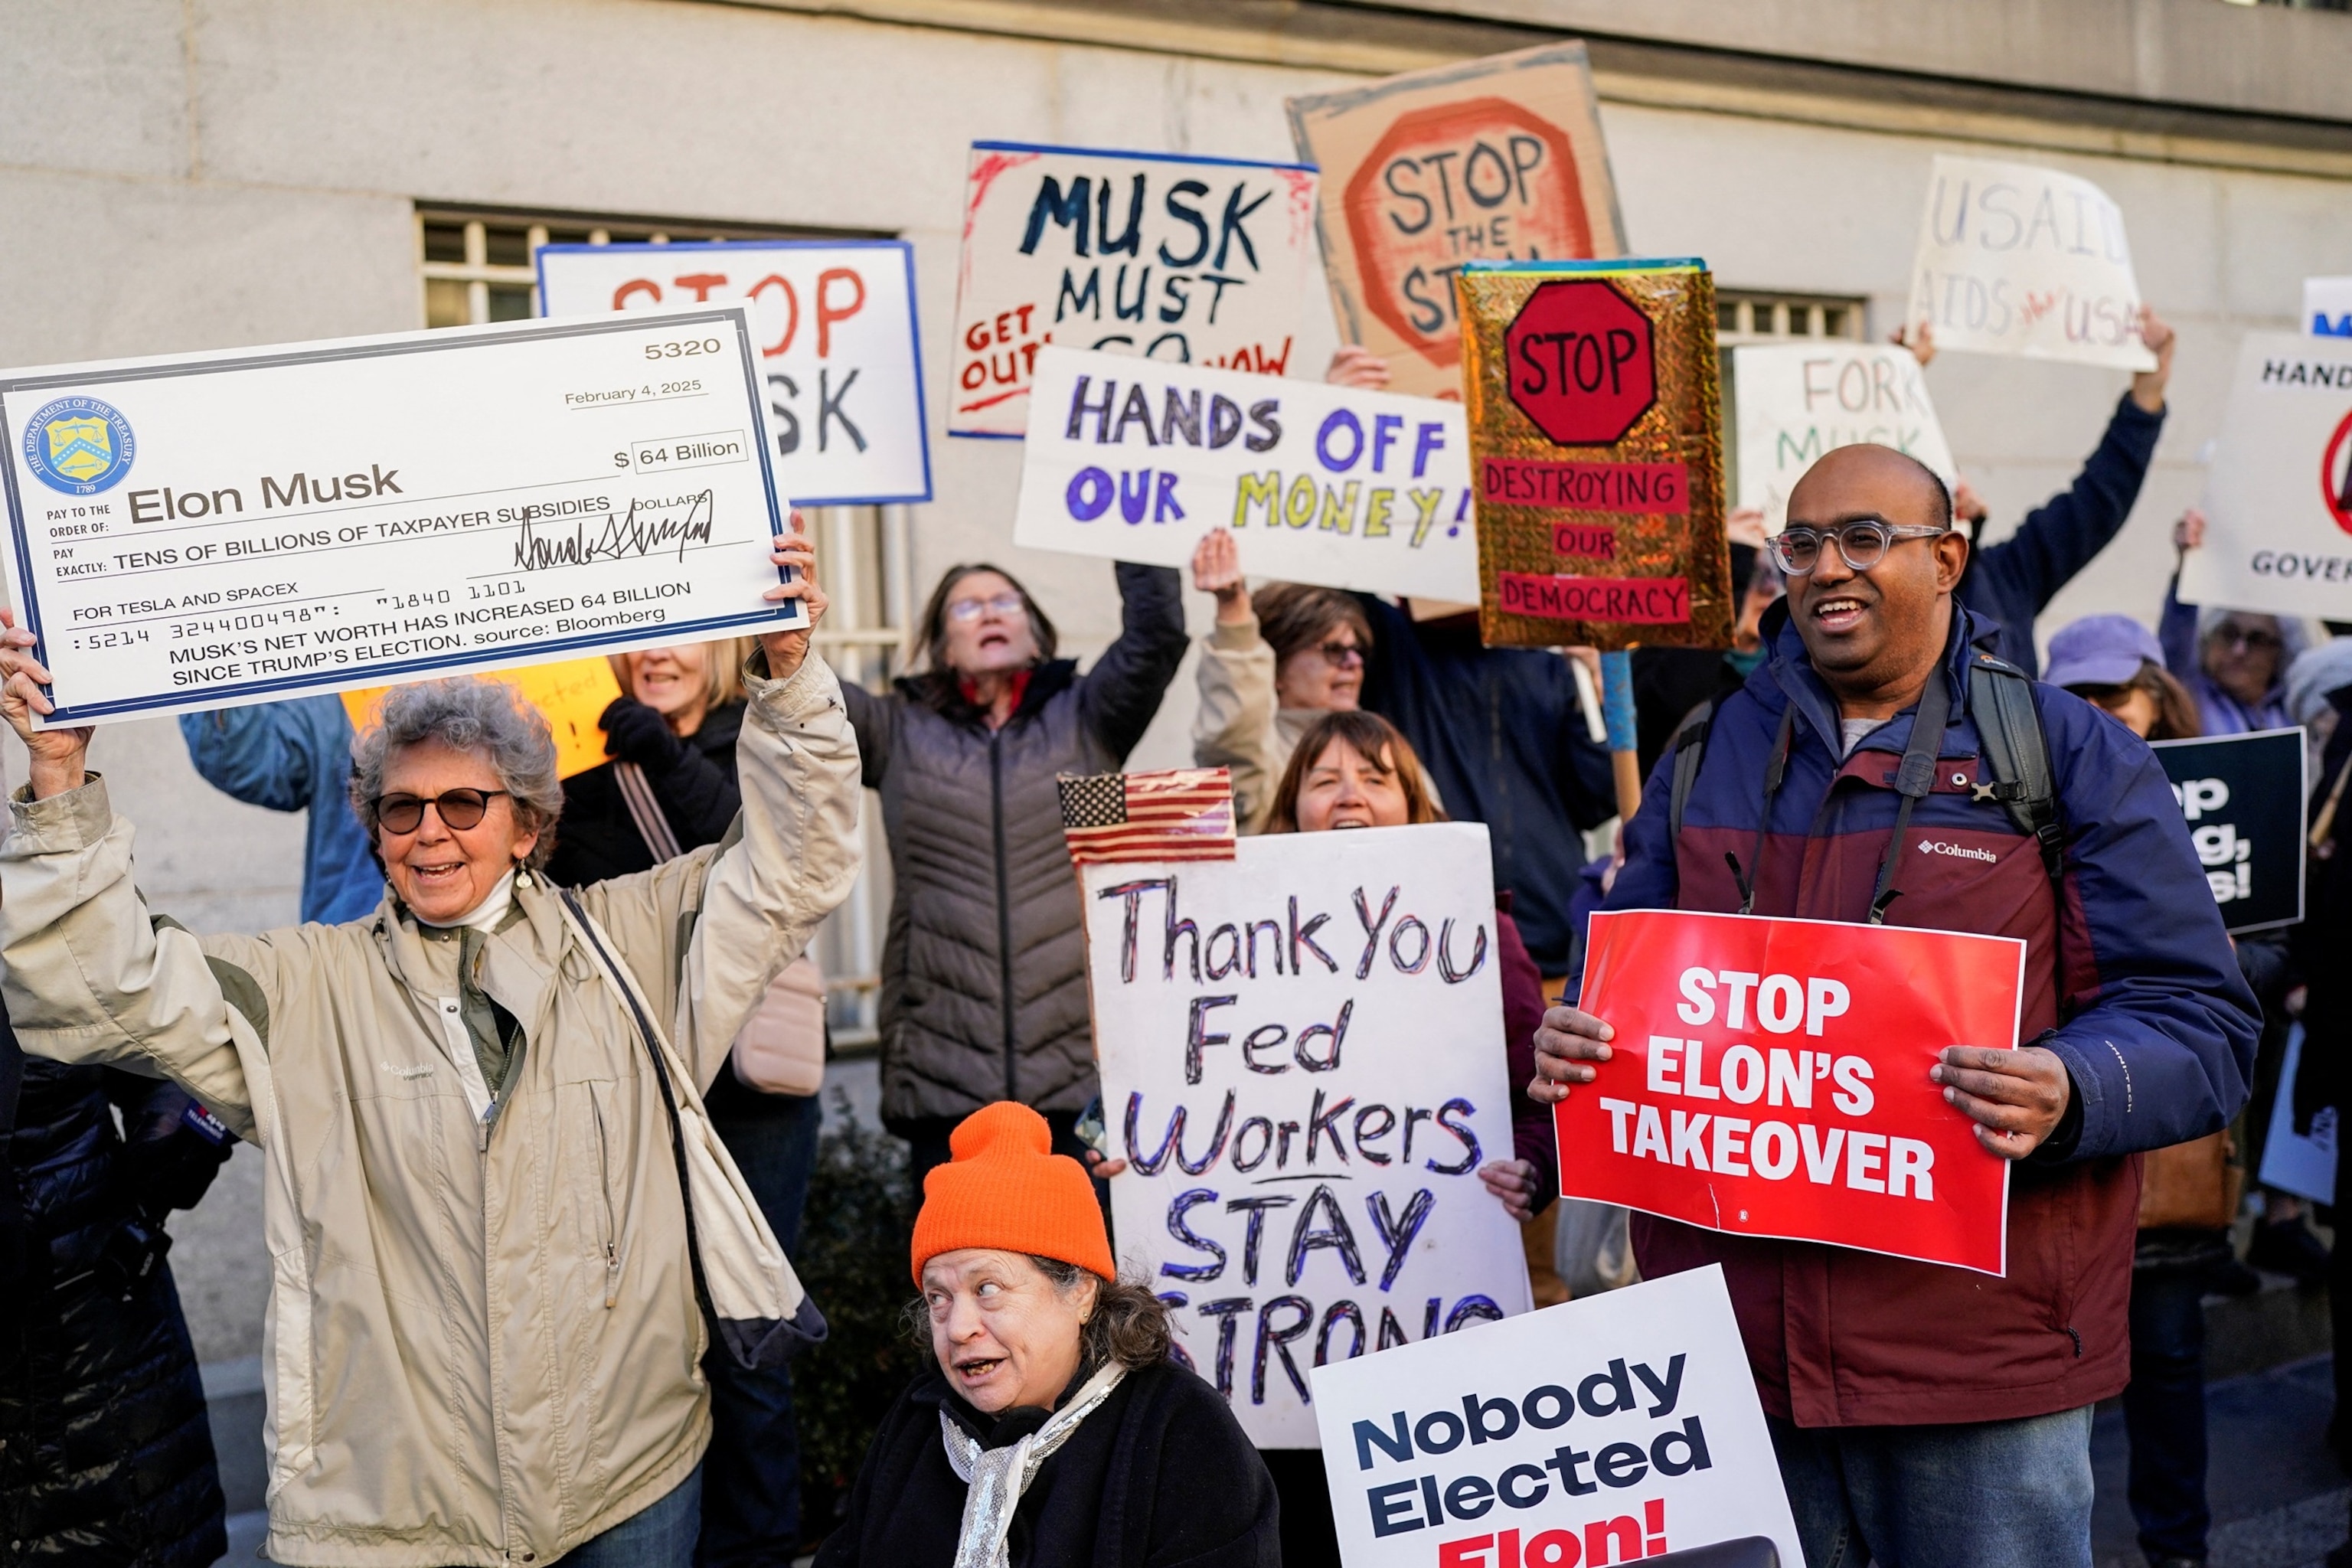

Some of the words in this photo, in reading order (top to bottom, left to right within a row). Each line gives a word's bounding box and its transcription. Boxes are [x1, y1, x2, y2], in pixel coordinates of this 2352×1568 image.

[1385, 136, 1544, 234] STOP
[1018, 174, 1272, 272] MUSK
[1448, 216, 1511, 253] THE
[1931, 175, 2130, 266] USAID
[1055, 265, 1246, 325] MUST
[645, 338, 721, 360] 5320
[966, 305, 1035, 351] GET
[1520, 328, 1636, 396] STOP
[1803, 357, 1931, 420] FORK
[73, 399, 87, 407] OF
[90, 401, 112, 416] THE
[565, 387, 635, 405] February
[642, 385, 656, 397] 4,
[662, 380, 701, 394] 2025
[767, 369, 867, 455] SK
[26, 400, 70, 452] DEPARTMENT
[113, 414, 132, 466] TREASURY
[614, 452, 629, 469] $
[639, 448, 668, 464] 64
[676, 440, 740, 460] Billion
[1066, 375, 1282, 452] HANDS
[1316, 408, 1446, 478] OFF
[28, 454, 44, 475] THE
[77, 484, 96, 494] 1789
[128, 486, 243, 524] Elon
[261, 464, 403, 508] Musk
[1485, 466, 1675, 507] DESTROYING
[47, 508, 68, 520] PAY
[72, 507, 86, 518] TO
[89, 504, 110, 515] THE
[50, 523, 87, 538] ORDER
[91, 521, 109, 533] OF:
[633, 493, 707, 511] DOLLARS
[1067, 466, 1186, 524] OUR
[1233, 471, 1471, 549] MONEY!
[54, 548, 74, 559] PAY
[56, 563, 107, 577] EXACTLY:
[113, 549, 178, 570] TENS
[185, 544, 217, 561] OF
[226, 531, 331, 557] BILLIONS
[338, 526, 368, 543] OF
[374, 511, 490, 537] TAXPAYER
[497, 496, 611, 523] SUBSIDIES
[1557, 528, 1614, 560] OUR
[73, 606, 113, 621] FOR
[117, 597, 176, 616] TESLA
[183, 590, 221, 607] AND
[226, 582, 299, 602] SPACEX
[469, 581, 526, 599] 1101
[1504, 578, 1684, 619] DEMOCRACY
[170, 637, 258, 665] MUSK'S
[266, 633, 308, 651] NET
[315, 620, 397, 644] WORTH
[404, 615, 448, 632] HAS
[456, 598, 574, 626] INCREASED
[581, 593, 606, 609] 64
[613, 582, 692, 604] BILLION
[173, 664, 243, 685] SINCE
[247, 649, 348, 675] TRUMP'S
[355, 637, 466, 661] ELECTION.
[475, 625, 549, 644] source:
[557, 608, 665, 633] Bloomberg
[1934, 842, 1996, 863] Columbia
[1096, 874, 1339, 984] Thank
[1351, 884, 1488, 984] You
[1677, 966, 1851, 1037] STOP
[390, 1062, 434, 1076] Columbia
[1185, 994, 1354, 1085] Fed
[1647, 1035, 1874, 1116] ELON'S
[2105, 1040, 2132, 1112] OMNI-TECH
[1123, 1087, 1482, 1176] Workers
[1599, 1097, 1935, 1200] TAKEOVER
[1161, 1184, 1436, 1292] STAY
[1351, 1352, 1687, 1472] Nobody
[1367, 1415, 1713, 1538] Elected
[1439, 1498, 1668, 1568] Elon!
